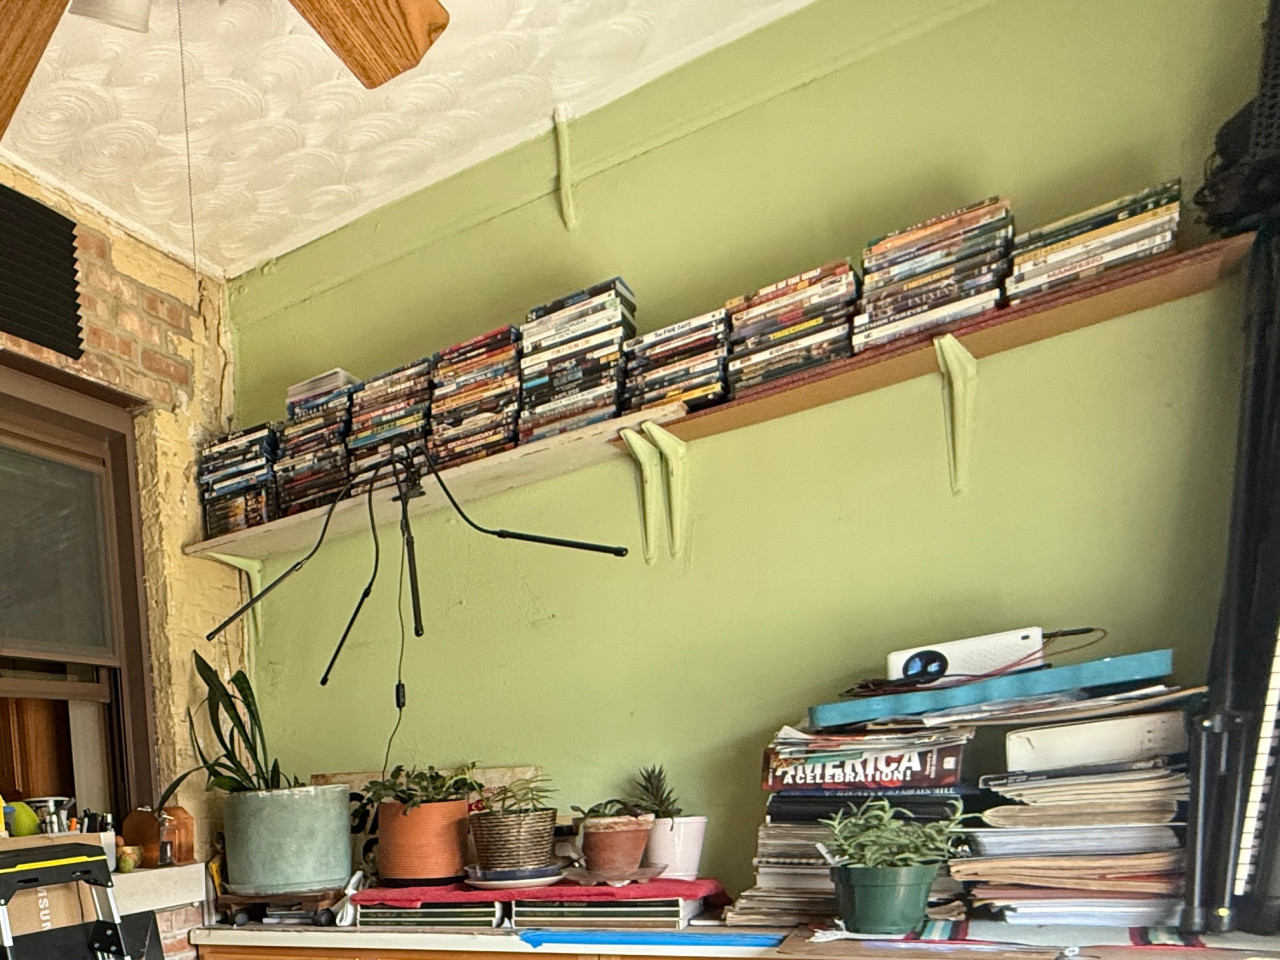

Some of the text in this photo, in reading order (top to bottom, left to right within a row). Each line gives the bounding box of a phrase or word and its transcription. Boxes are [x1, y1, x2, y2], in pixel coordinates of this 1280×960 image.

[852, 304, 929, 333] BATMAN FOREVER
[782, 768, 912, 784] A CELEBRATION!
